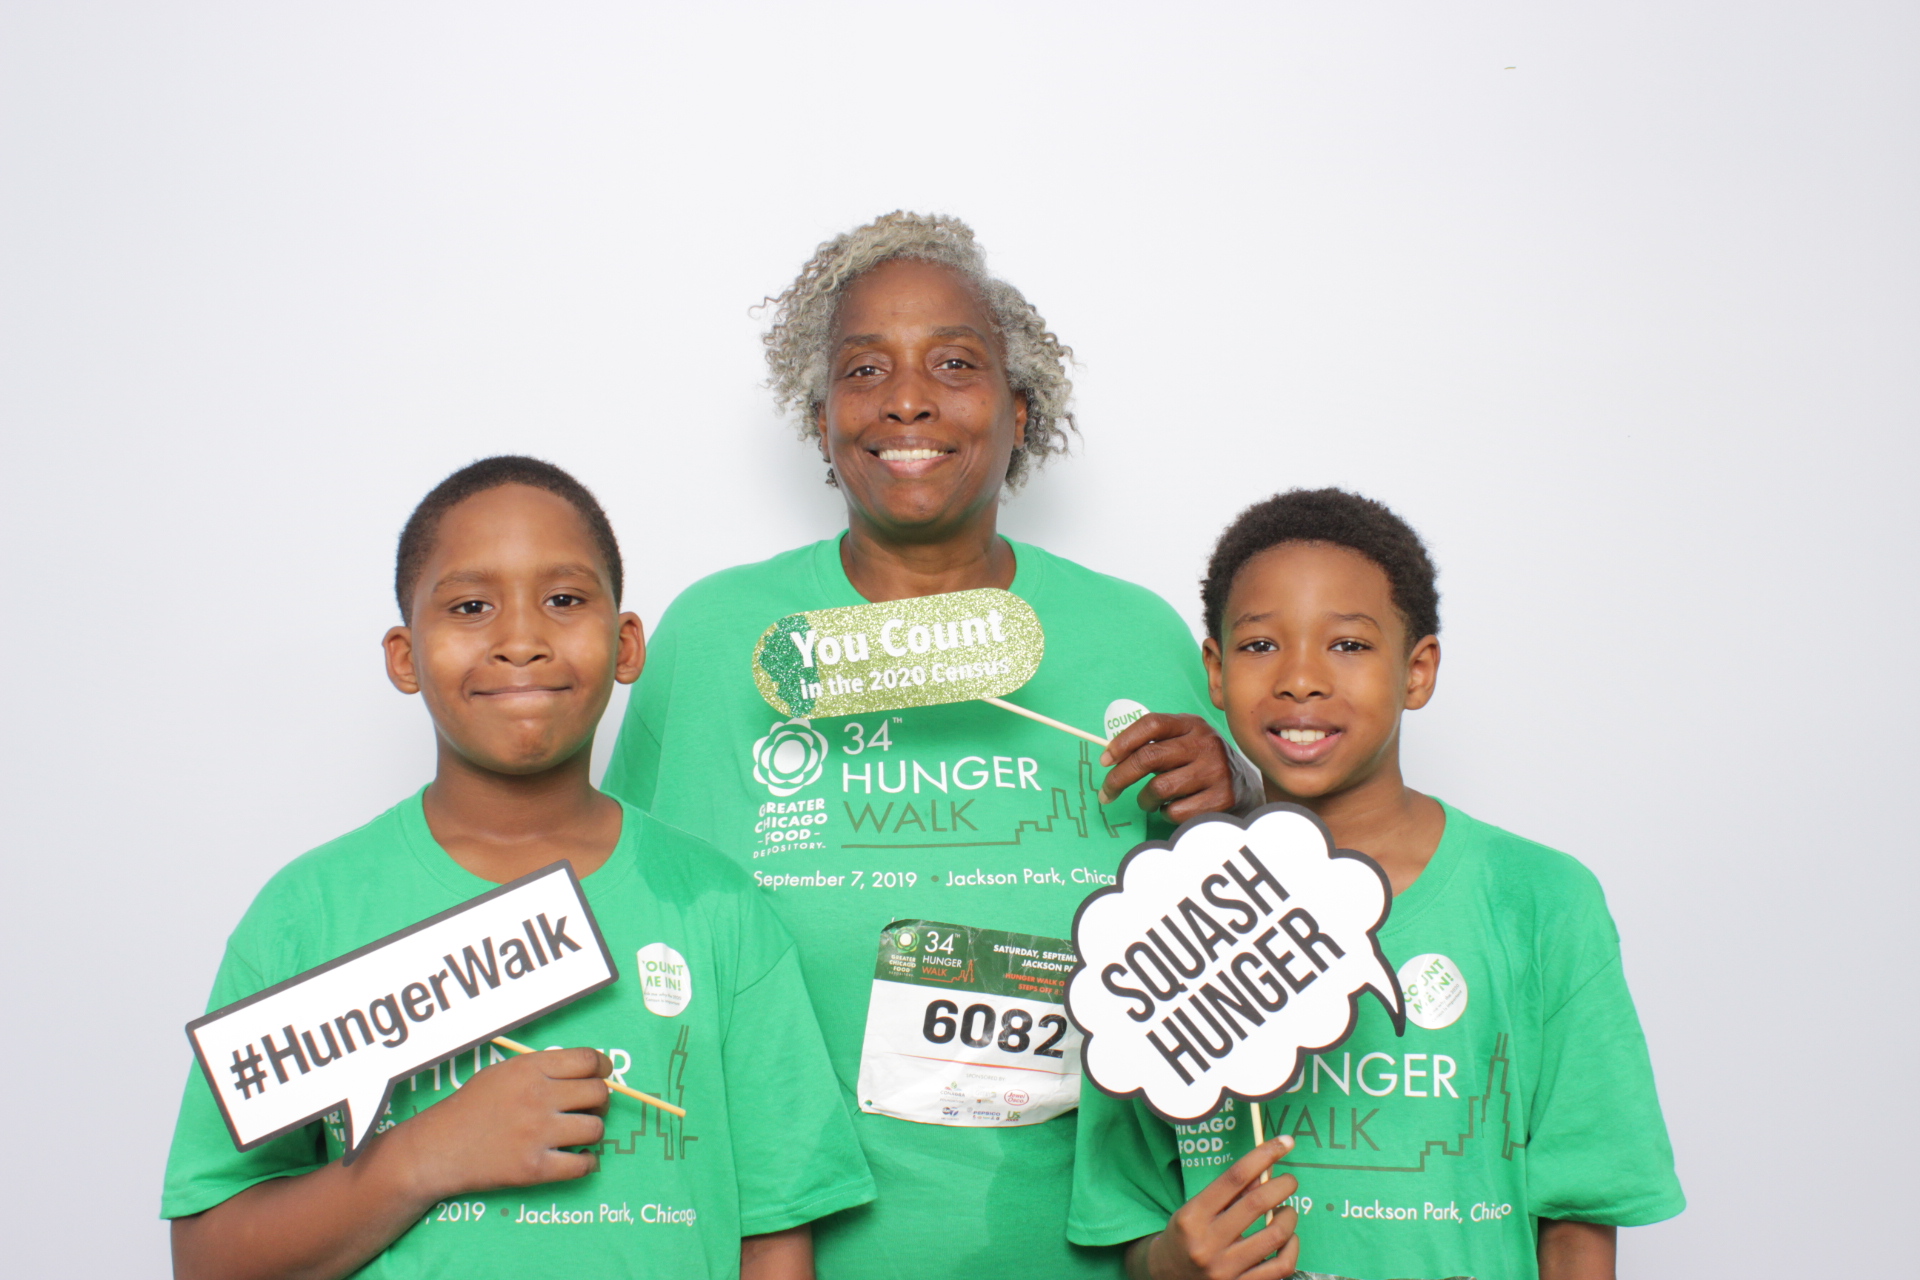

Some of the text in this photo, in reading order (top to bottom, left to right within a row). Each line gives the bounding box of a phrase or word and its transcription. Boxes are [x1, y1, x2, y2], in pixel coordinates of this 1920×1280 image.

[790, 609, 1005, 668] You Count
[800, 659, 1010, 700] in the 2020 Census
[1107, 709, 1143, 730] COUNT
[842, 756, 1042, 794] HUNGER
[759, 798, 825, 817] GREATER
[843, 799, 978, 834] WALK
[754, 813, 828, 833] CHICAGO
[753, 870, 845, 891] September
[851, 871, 865, 890] 7,
[872, 871, 918, 888] 2019
[945, 869, 1020, 888] Jackson
[1023, 868, 1066, 888] Park,
[1100, 845, 1291, 1023] SQUASH
[922, 955, 962, 968] HUNGER
[993, 944, 1040, 959] SATURDAY,
[642, 960, 684, 976] OUNT
[922, 966, 948, 977] WALK
[1021, 959, 1062, 971] JACKSON
[665, 977, 682, 991] IN!
[1004, 973, 1036, 982] HUNGER
[1037, 977, 1057, 986] WALK
[1018, 984, 1038, 992] STEPS
[229, 912, 583, 1100] #HungerWalk
[1146, 907, 1346, 1086] HUNGER
[922, 999, 1068, 1059] 6082
[437, 1202, 486, 1222] 2019
[515, 1203, 594, 1224] Jackson
[600, 1202, 634, 1225] Park,
[1341, 1199, 1417, 1220] Jackson
[1424, 1201, 1463, 1224] Park,
